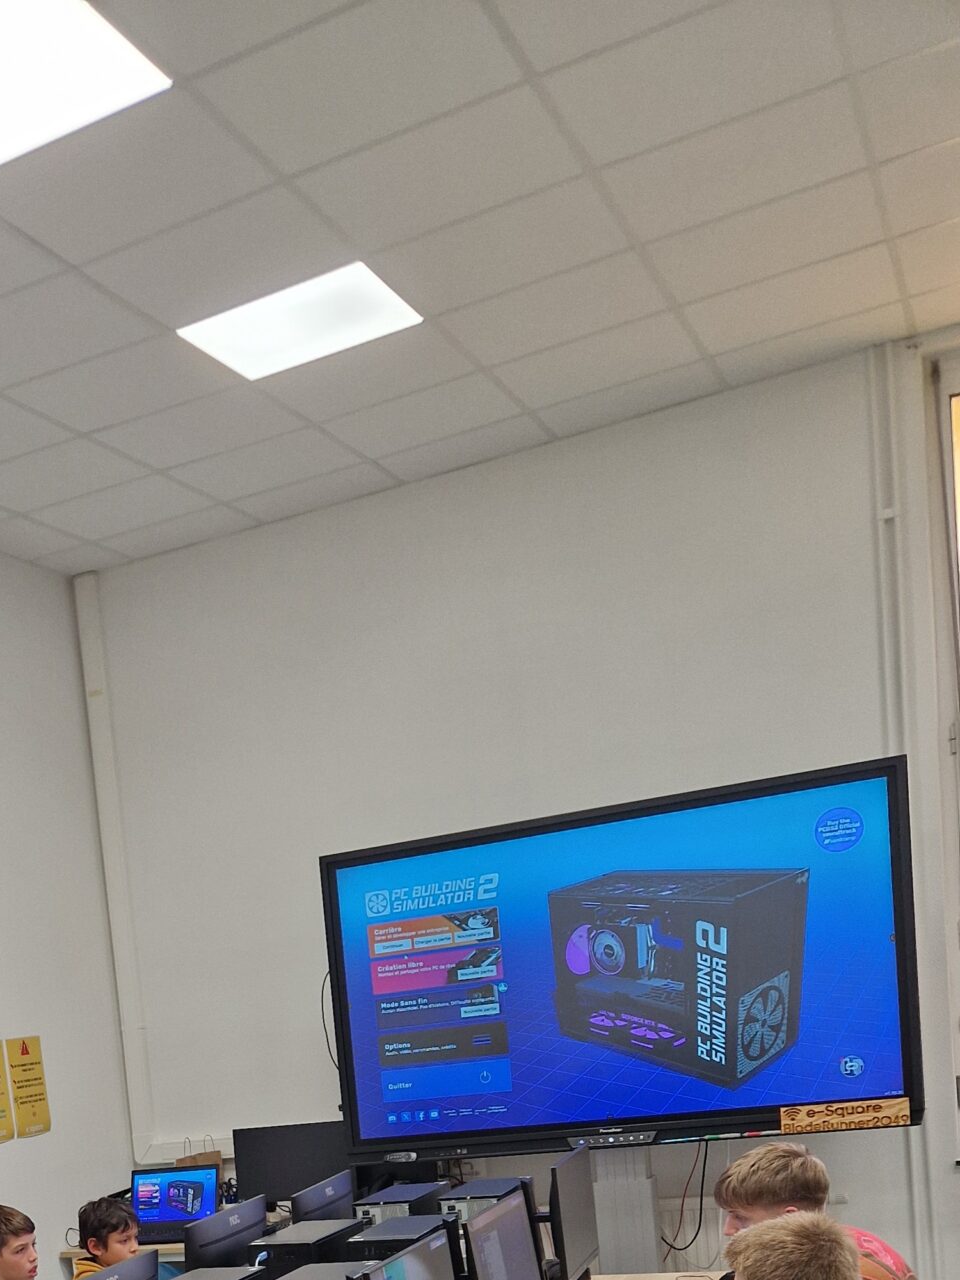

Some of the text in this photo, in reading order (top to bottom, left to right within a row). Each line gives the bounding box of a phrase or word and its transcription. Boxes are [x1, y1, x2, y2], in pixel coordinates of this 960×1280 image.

[391, 877, 475, 901] PC BUILDING
[477, 873, 499, 900] 2
[392, 890, 474, 913] SIMULATOR
[695, 920, 727, 955] 2
[697, 952, 711, 1061] PC BUILDING
[712, 957, 727, 1065] SIMULATOR
[384, 1042, 411, 1051] Options
[806, 1103, 883, 1118] e-Square
